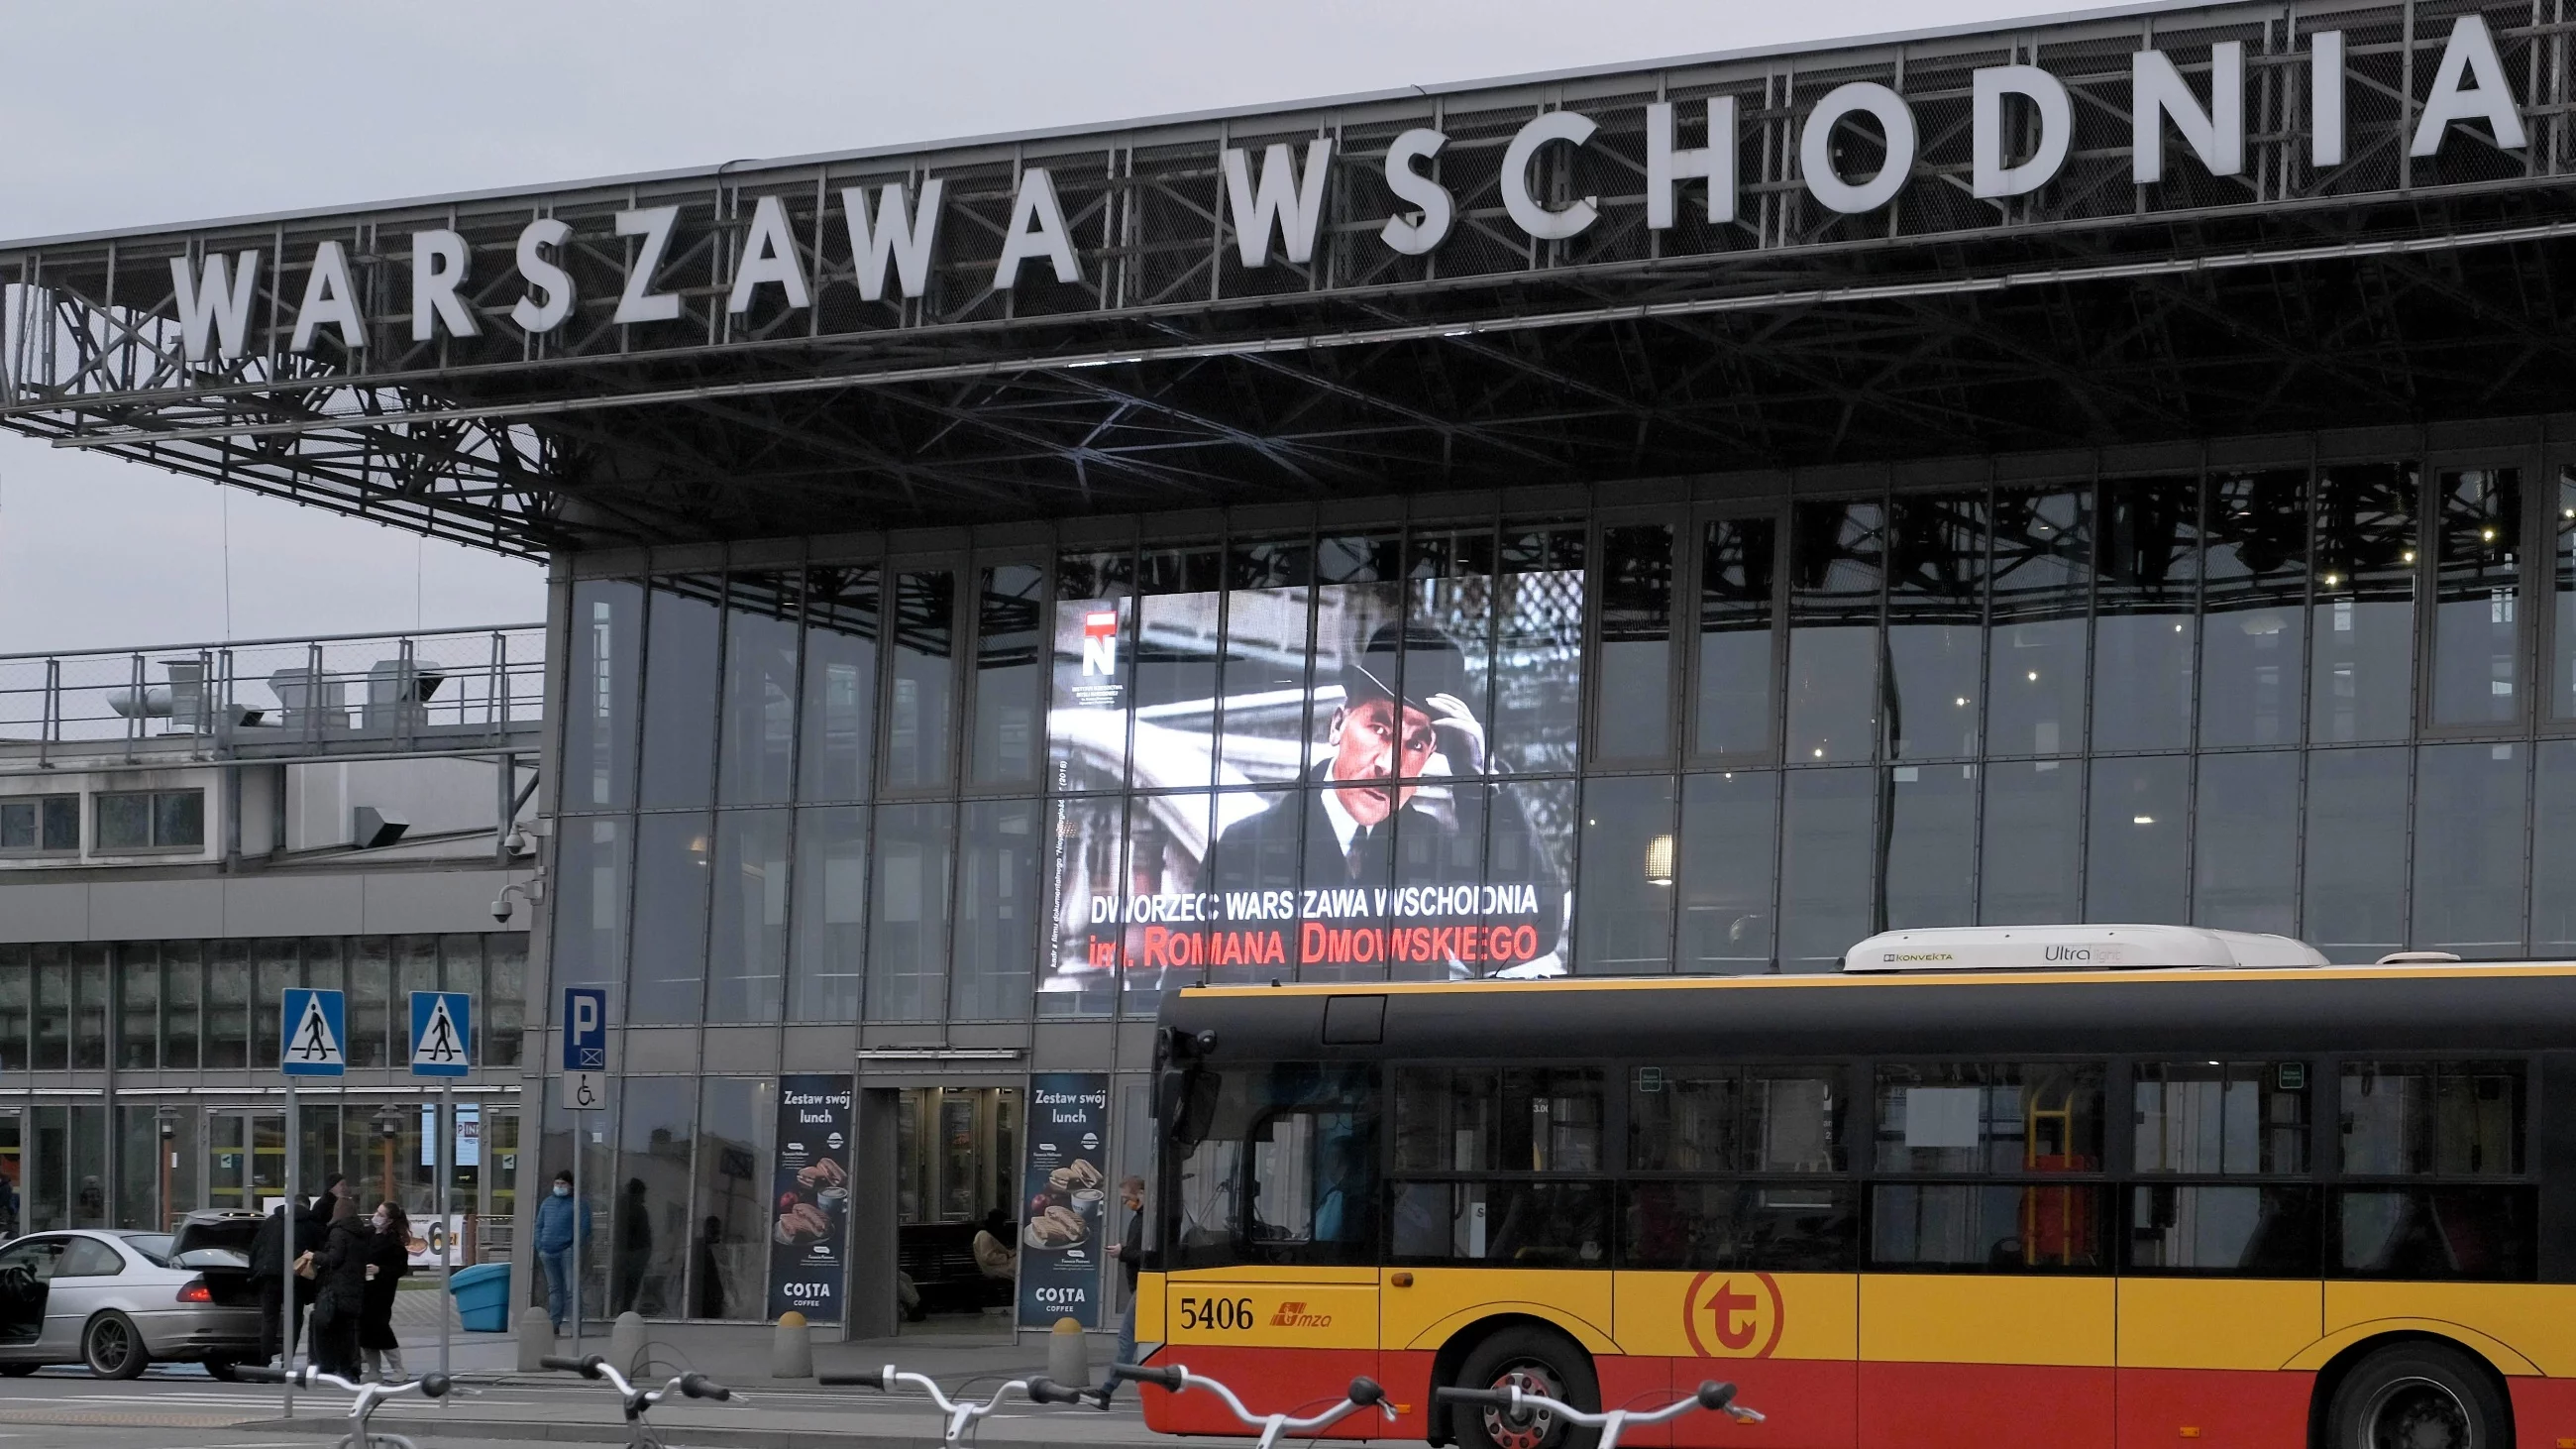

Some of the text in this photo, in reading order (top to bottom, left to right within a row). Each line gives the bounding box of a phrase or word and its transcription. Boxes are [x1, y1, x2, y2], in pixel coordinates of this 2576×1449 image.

[170, 13, 2527, 363] WARSZAWA WSCHODNIA
[1091, 884, 1539, 924] DWORZEC WARSZAWA WSCHODNIA
[1144, 926, 1286, 967] ROMANA
[1302, 922, 1538, 963] DMOWSKIEGO
[2045, 946, 2091, 961] Ultra
[574, 995, 597, 1046] P
[784, 1091, 851, 1109] Zestaw swój
[1035, 1090, 1106, 1109] Zestaw swój
[801, 1109, 832, 1123] lunch
[1052, 1108, 1087, 1123] lunch
[784, 1282, 830, 1298] COSTA
[1035, 1287, 1085, 1303] COSTA
[1181, 1298, 1253, 1329] 5406
[1297, 1315, 1332, 1327] mza
